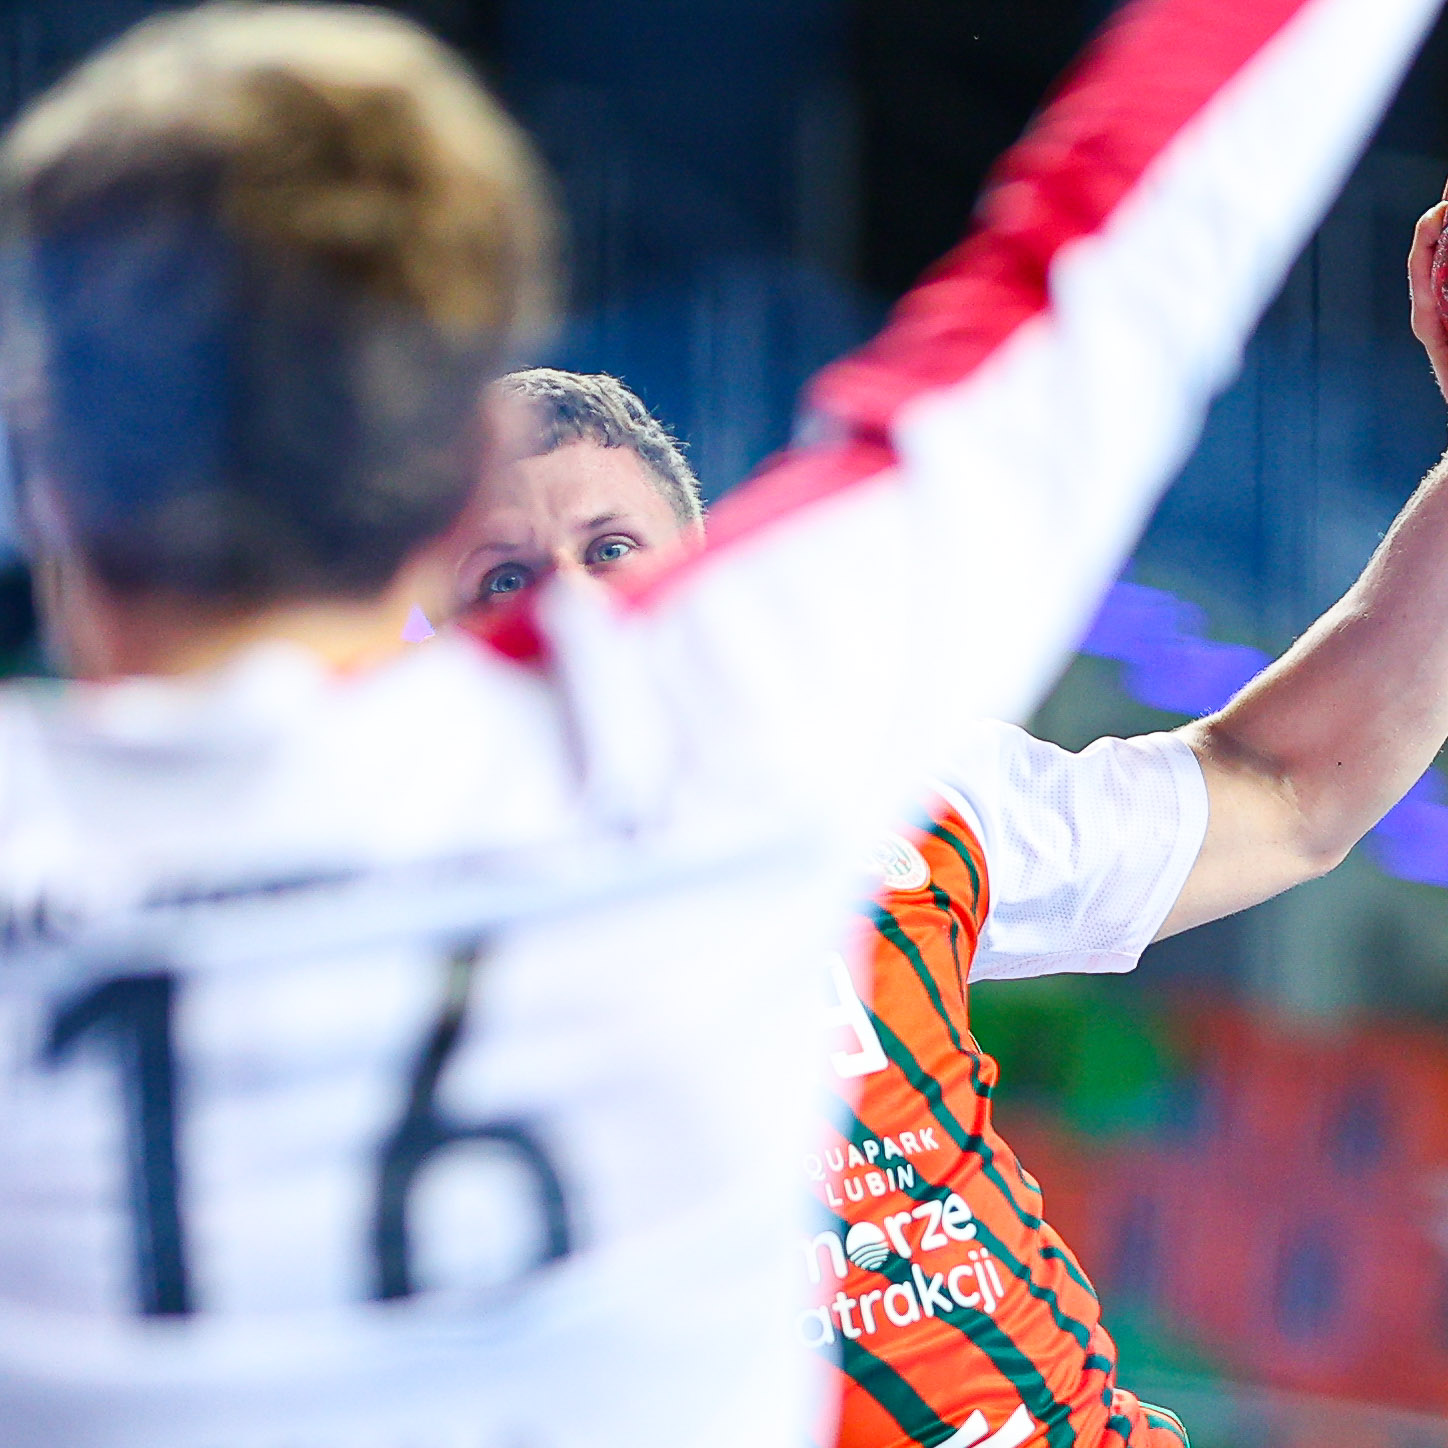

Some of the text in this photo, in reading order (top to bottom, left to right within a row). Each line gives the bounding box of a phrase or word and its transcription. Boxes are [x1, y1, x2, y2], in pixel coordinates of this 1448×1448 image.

[32, 930, 580, 1320] 16
[803, 1127, 939, 1181] QUAPARK
[824, 1164, 915, 1209] LUBIN
[794, 1248, 1004, 1349] atrakcji
